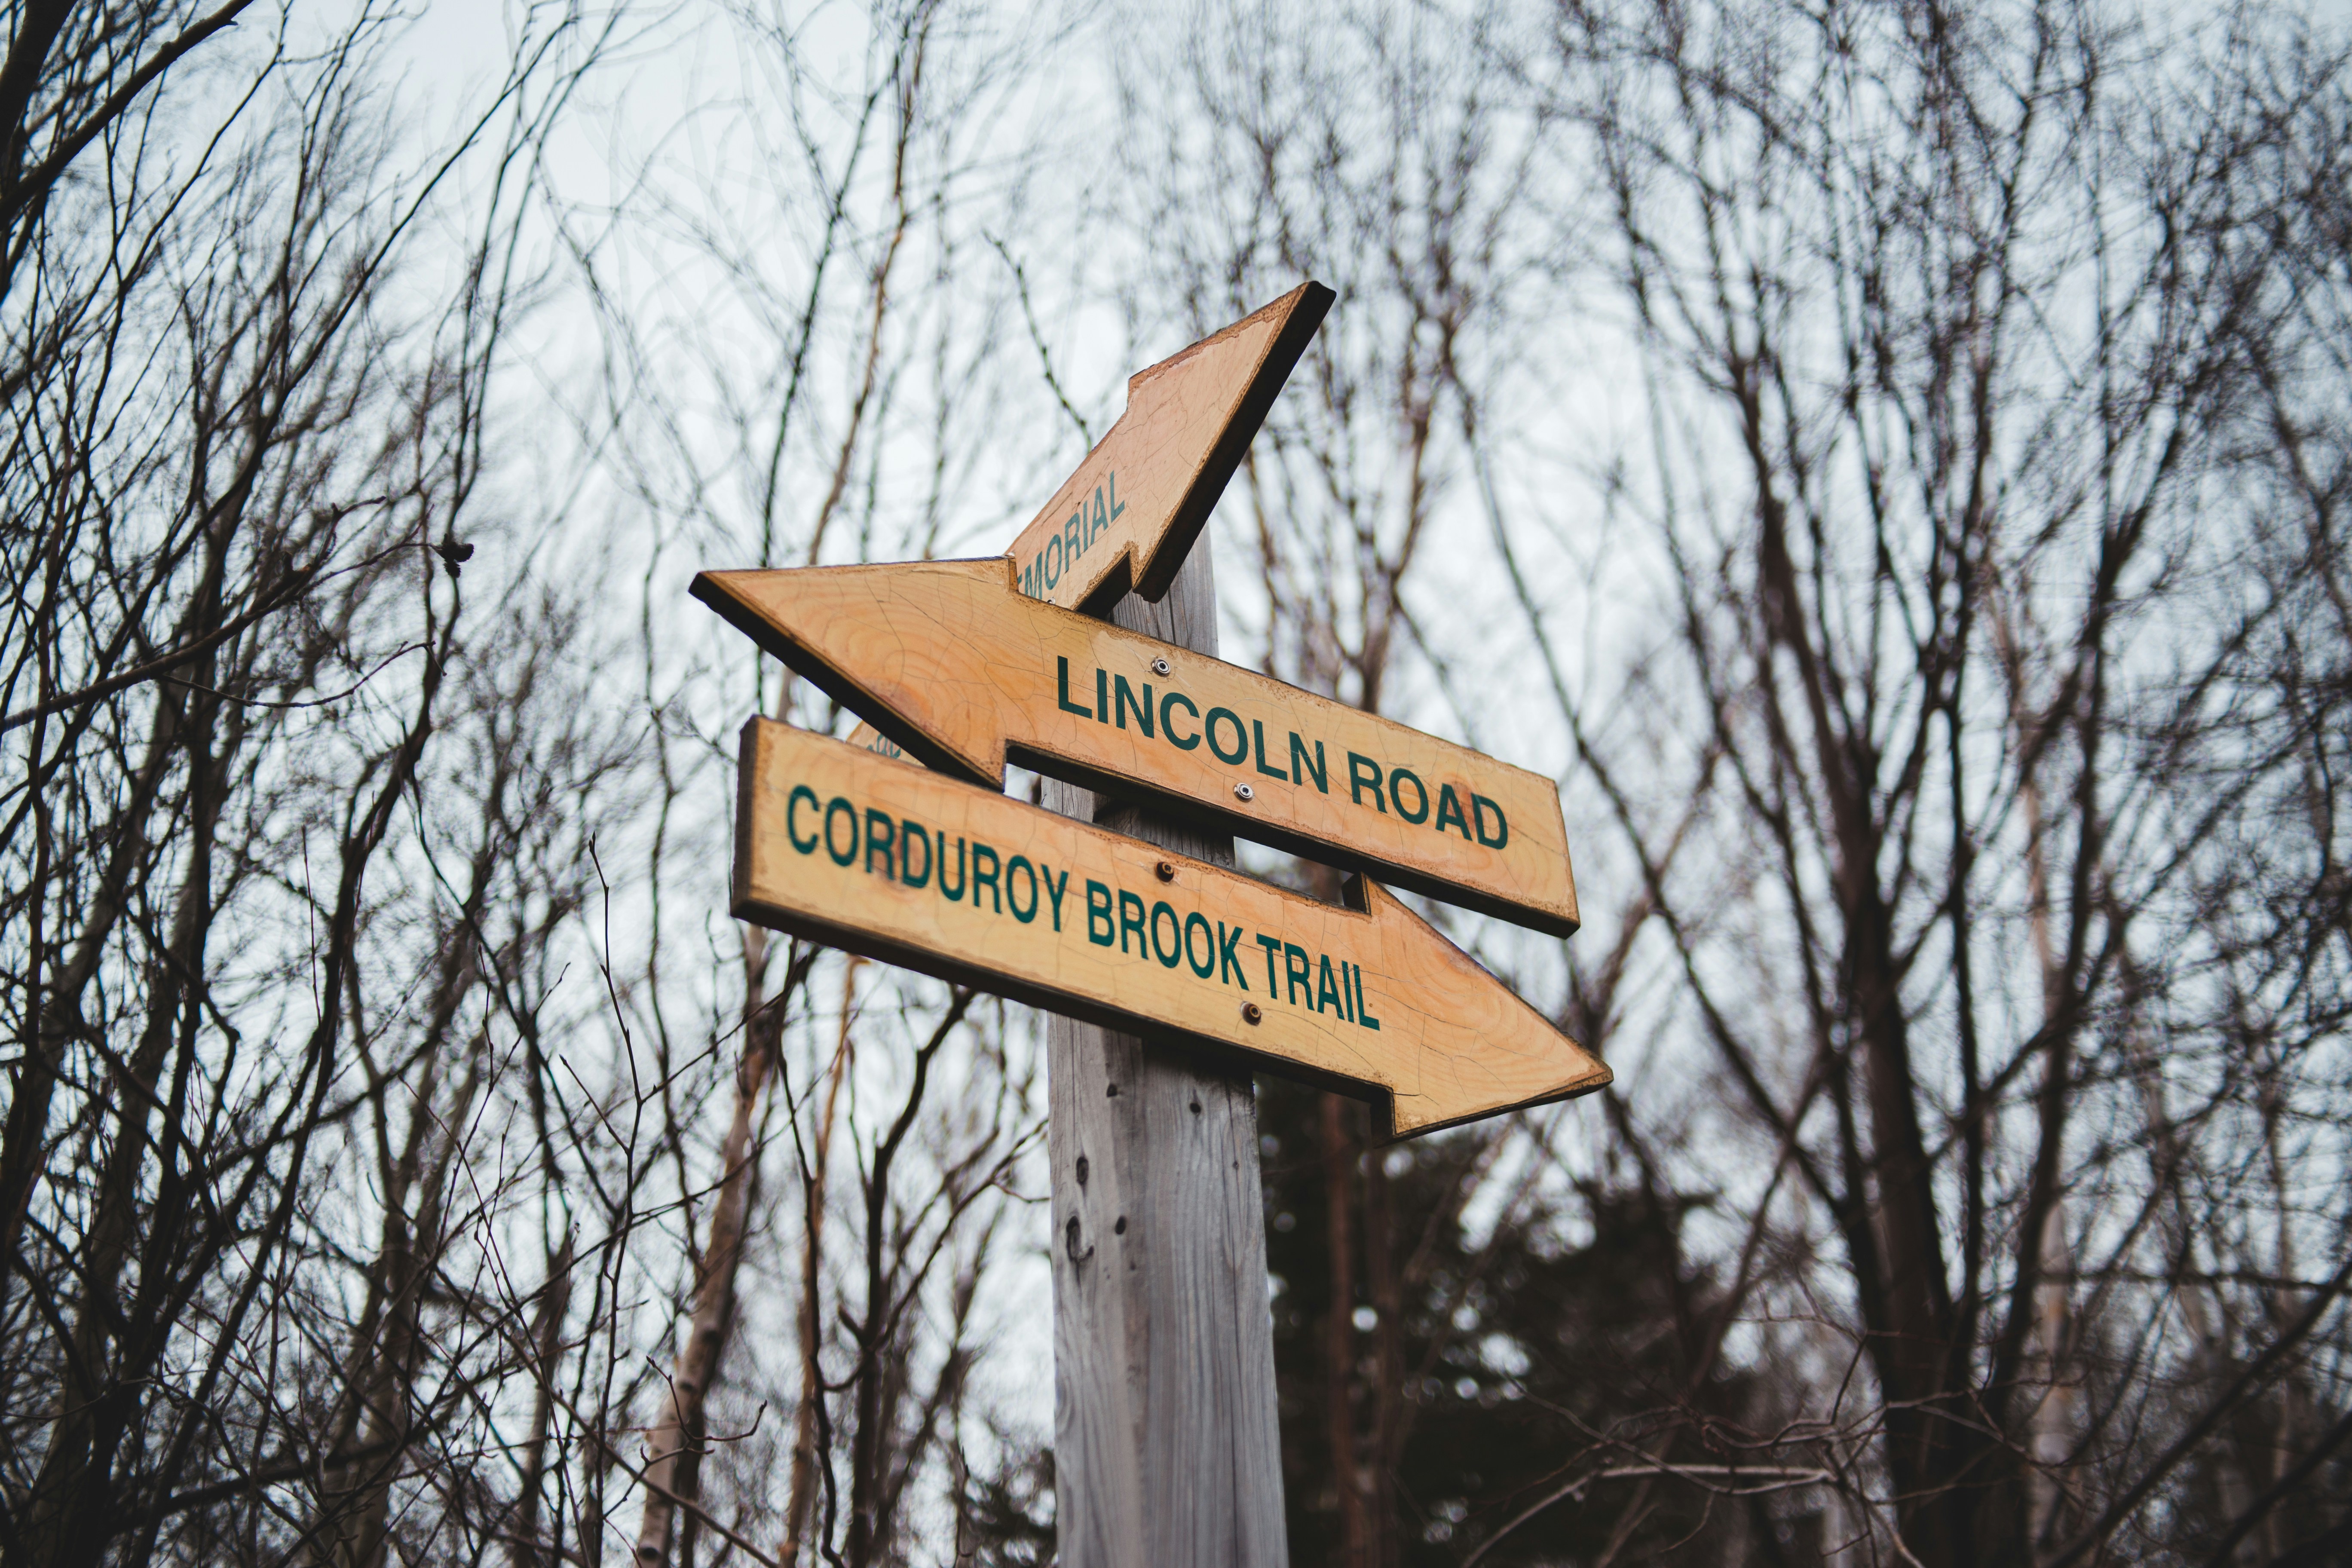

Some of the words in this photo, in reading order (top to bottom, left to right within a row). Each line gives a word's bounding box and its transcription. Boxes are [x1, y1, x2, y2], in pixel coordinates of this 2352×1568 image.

[1017, 470, 1125, 600] MORIAL
[1057, 655, 1329, 795] LINCOLN
[1347, 750, 1509, 850] ROAD
[786, 784, 1069, 933] CORDUROY
[1085, 878, 1250, 991] BROOK
[1256, 933, 1381, 1032] TRAIL
